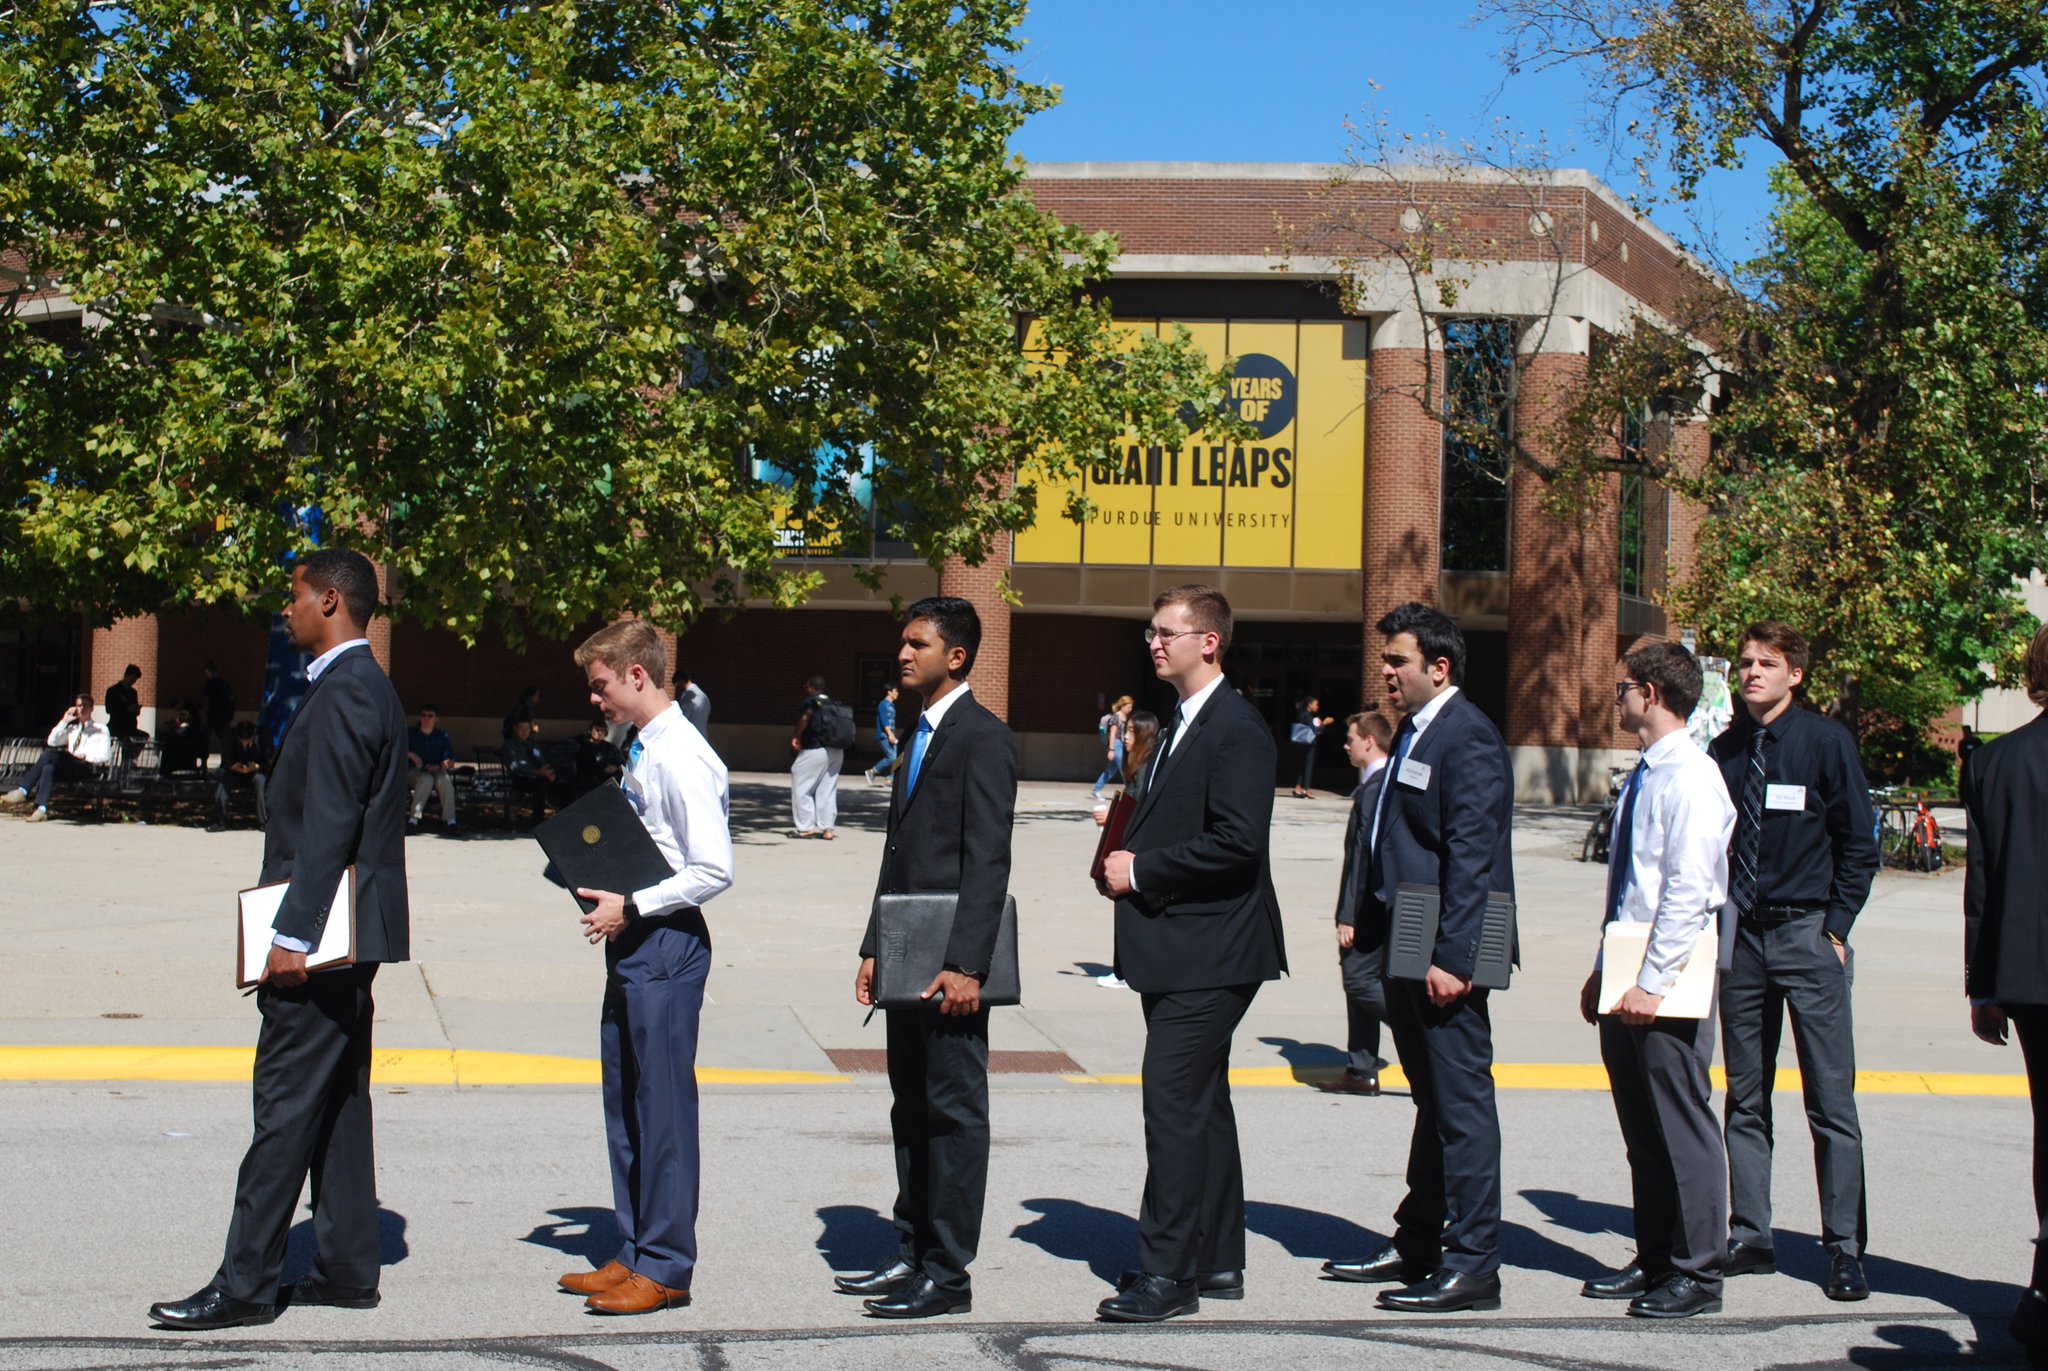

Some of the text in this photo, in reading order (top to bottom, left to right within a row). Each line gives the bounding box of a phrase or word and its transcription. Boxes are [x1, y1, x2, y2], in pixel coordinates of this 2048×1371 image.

[1231, 377, 1283, 400] YEARS
[1240, 400, 1270, 422] OF
[1191, 446, 1292, 488] LEAPS
[1089, 510, 1291, 528] PURDUE UNIVERSITY
